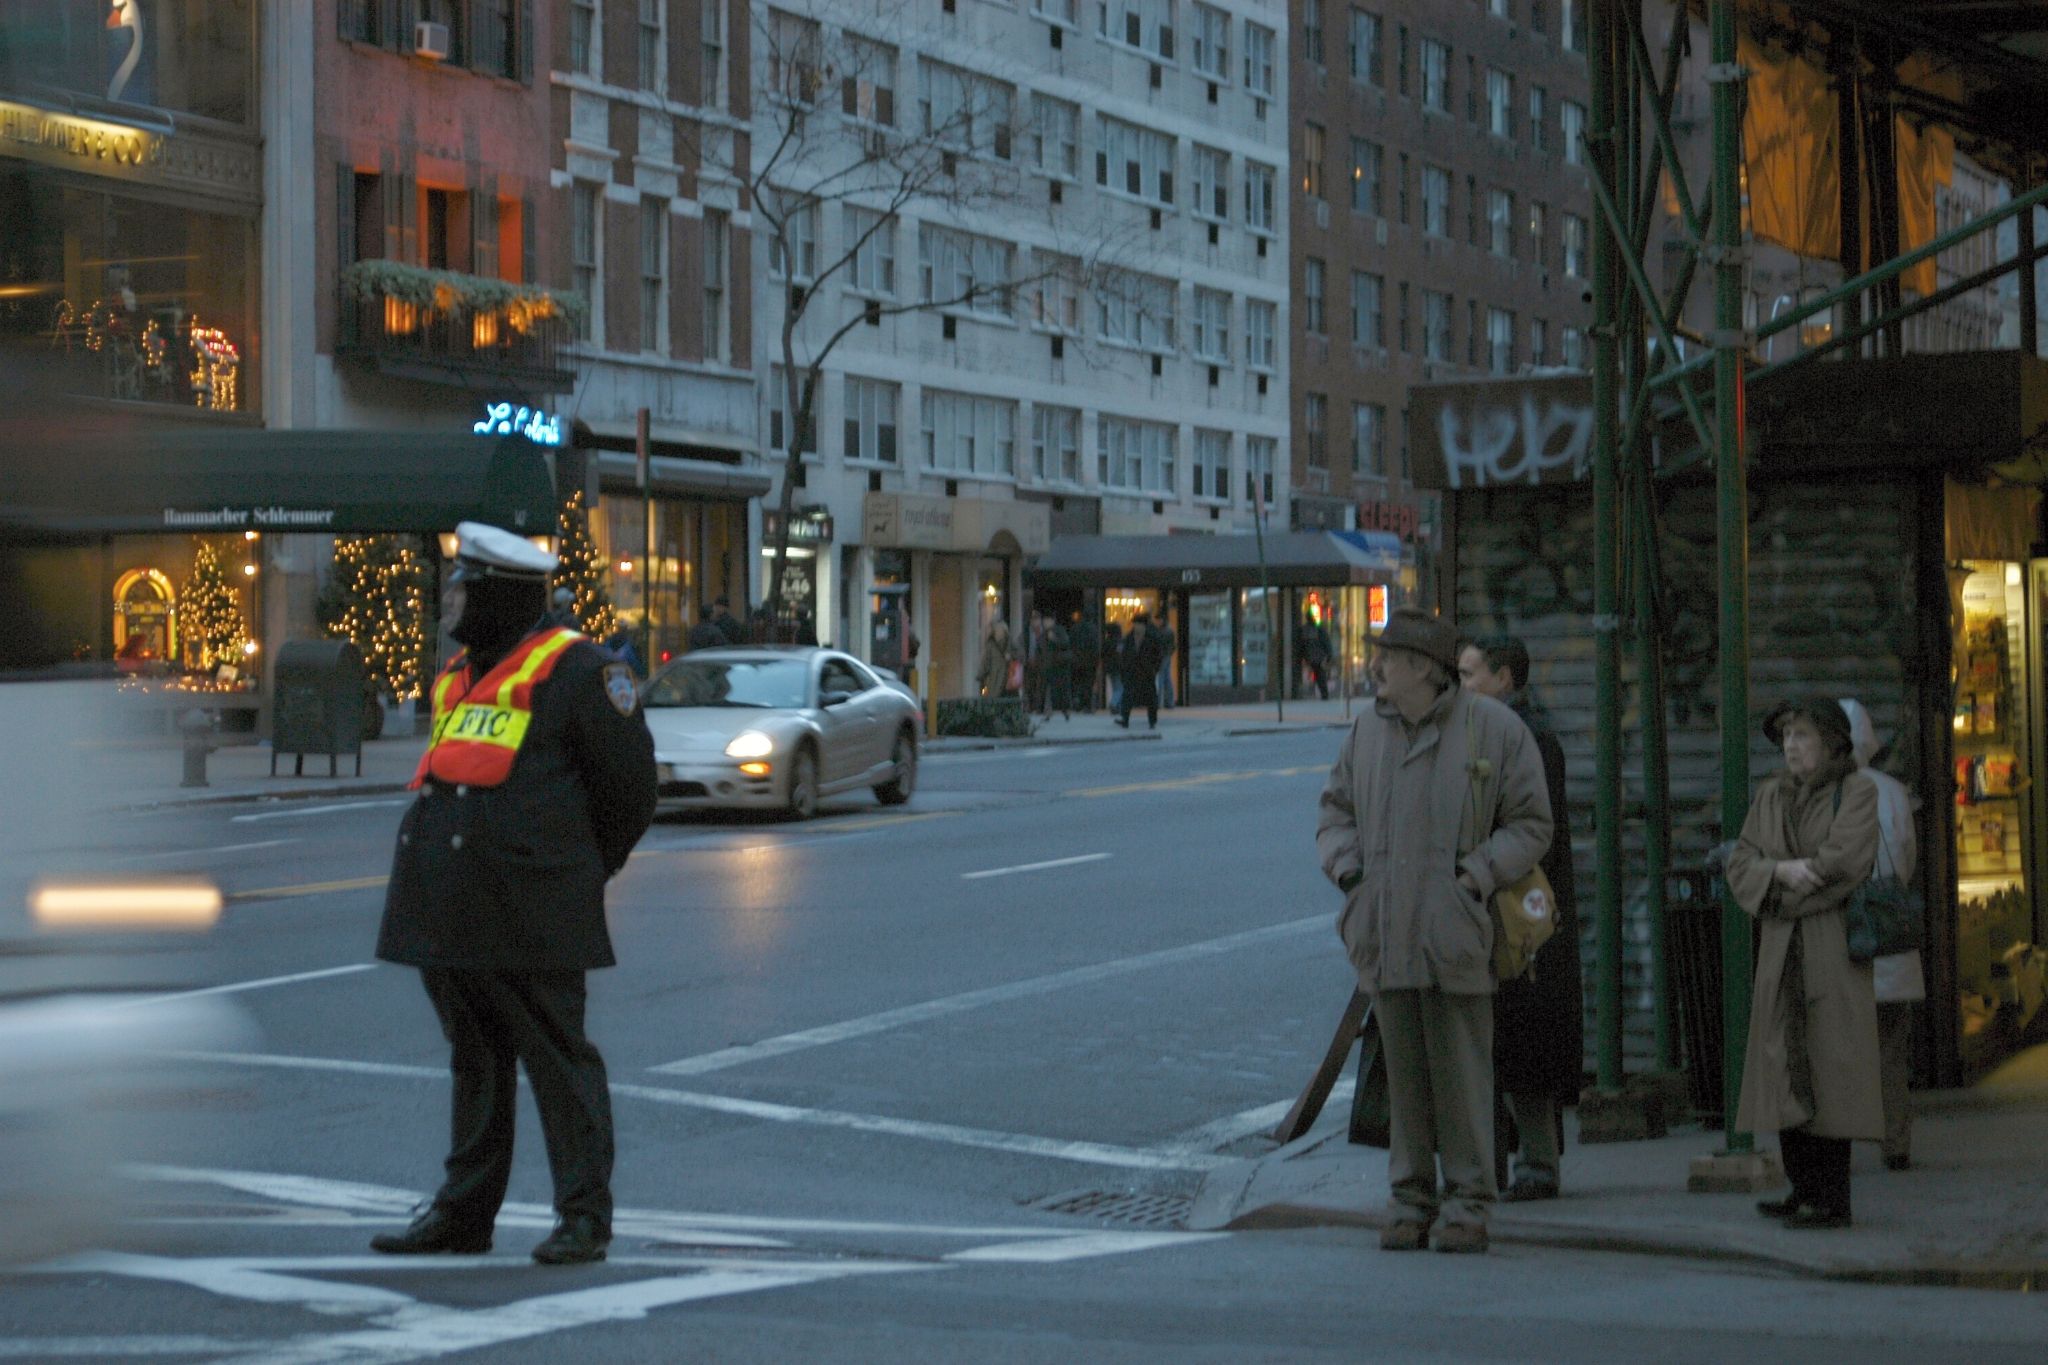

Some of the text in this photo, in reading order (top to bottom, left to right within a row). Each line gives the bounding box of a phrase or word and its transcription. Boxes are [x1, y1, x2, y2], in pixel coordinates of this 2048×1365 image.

[164, 506, 334, 526] Hammacher Schlemmer
[455, 708, 511, 738] FIC
